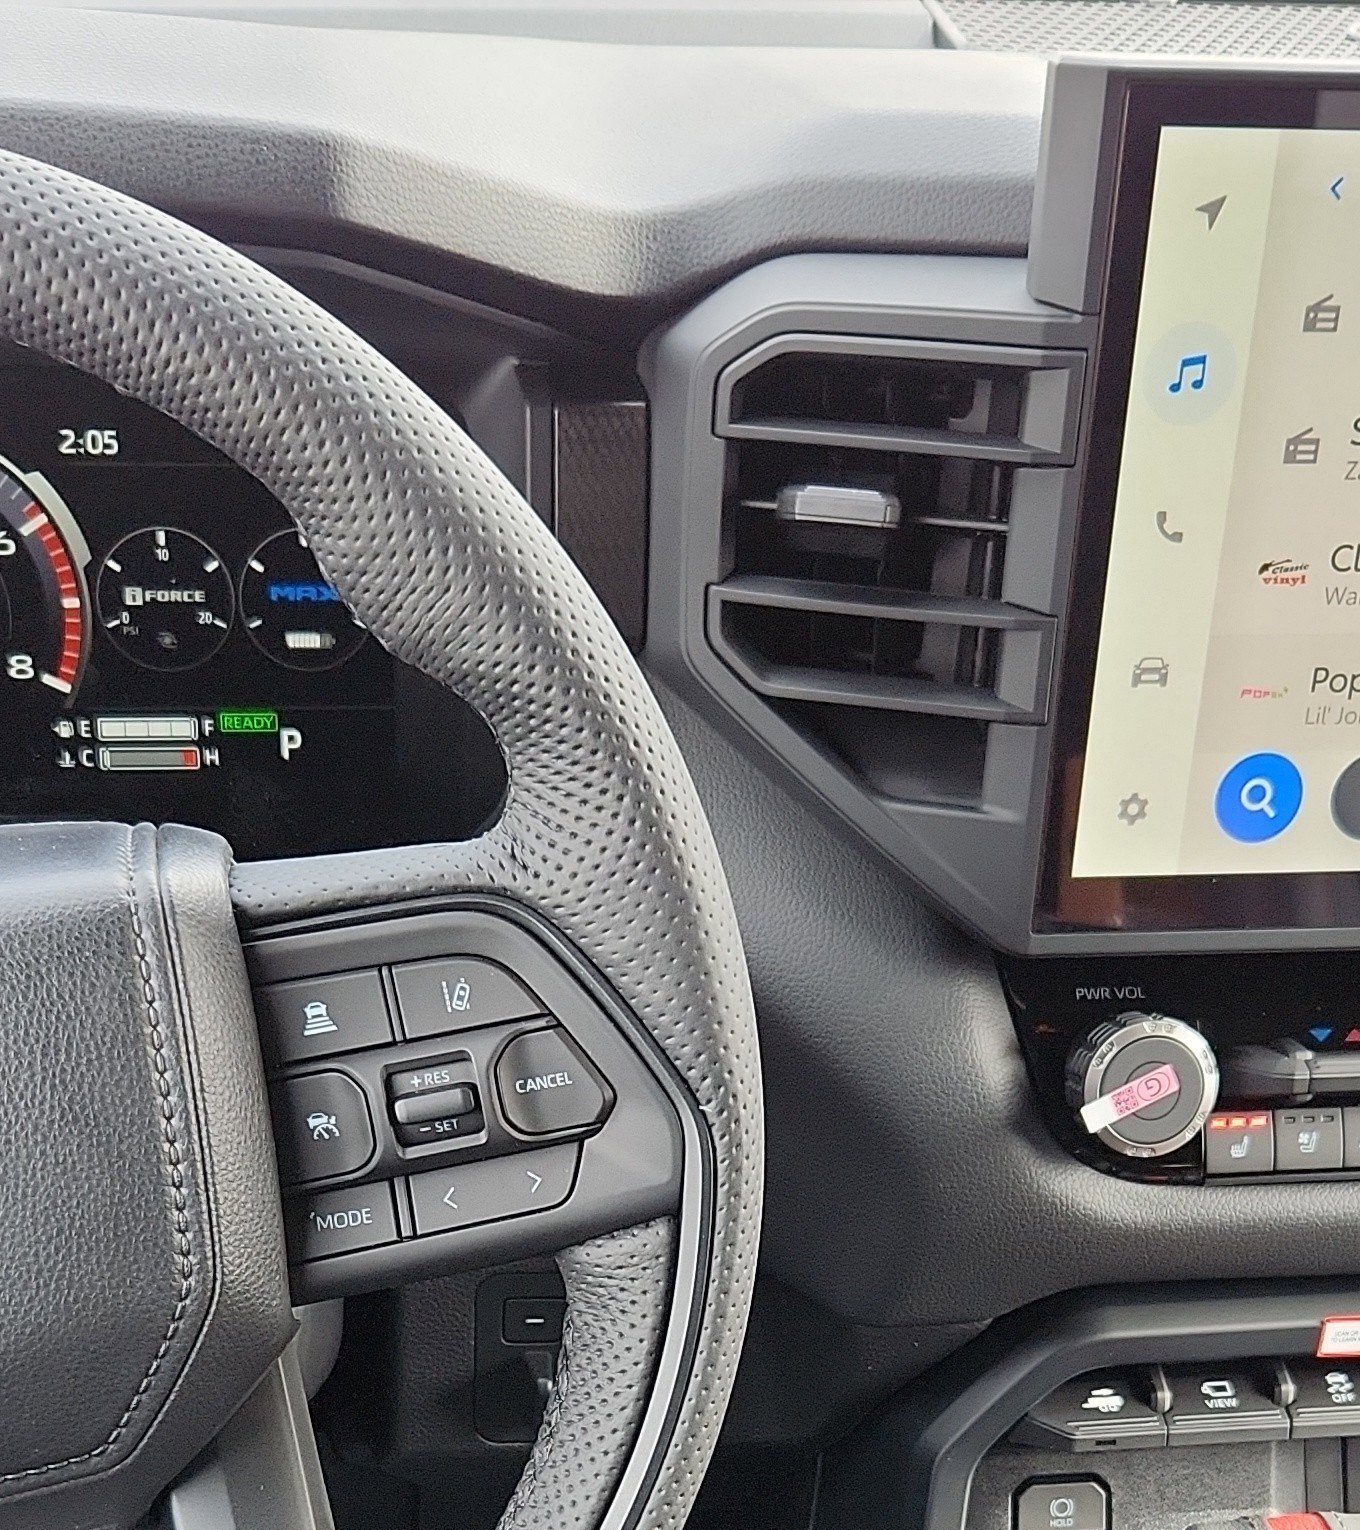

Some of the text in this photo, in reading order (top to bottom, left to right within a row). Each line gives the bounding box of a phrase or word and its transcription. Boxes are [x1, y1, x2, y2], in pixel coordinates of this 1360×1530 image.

[57, 428, 120, 457] 2:05
[154, 548, 170, 563] 10
[121, 611, 130, 626] 0
[198, 611, 214, 626] 20
[5, 654, 36, 681] 8
[223, 714, 276, 731] READY
[1304, 703, 1332, 726] Lil'
[79, 720, 215, 738] E F
[280, 727, 303, 762] P
[79, 748, 221, 768] C H
[1075, 985, 1146, 1002] PWR VOL
[424, 1069, 451, 1086] RES
[514, 1071, 574, 1095] CANCEL
[434, 1118, 460, 1133] SET
[314, 1207, 374, 1232] MODE
[1204, 1397, 1239, 1410] VIEW
[1331, 1392, 1357, 1404] OFF
[1049, 1518, 1074, 1528] HOLD
